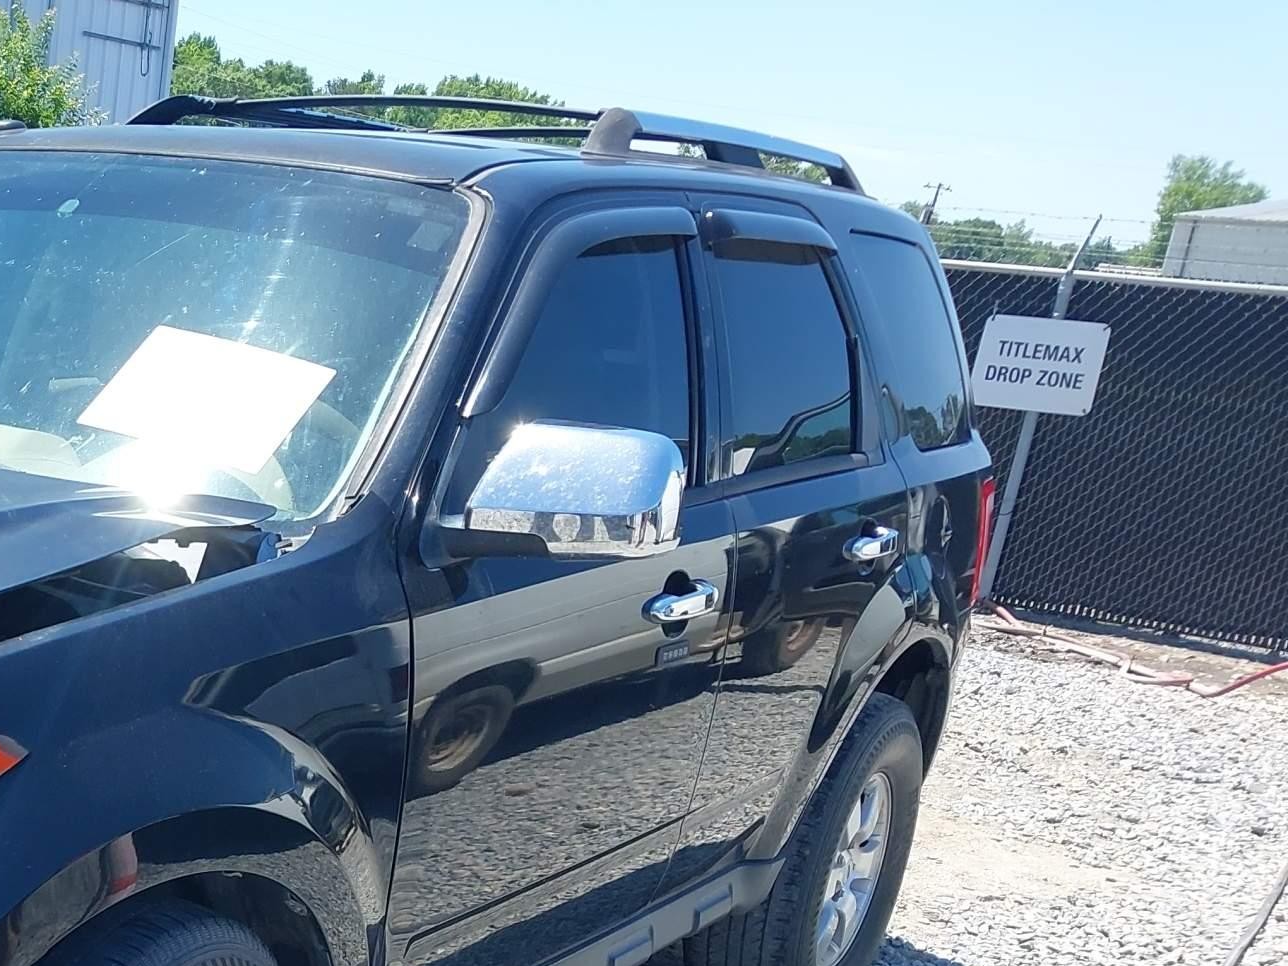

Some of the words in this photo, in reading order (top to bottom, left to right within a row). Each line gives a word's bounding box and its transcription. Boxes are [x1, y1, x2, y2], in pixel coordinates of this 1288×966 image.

[998, 340, 1086, 363] TITLEMAX
[984, 365, 1033, 384] DROP
[1035, 370, 1086, 390] ZONE
